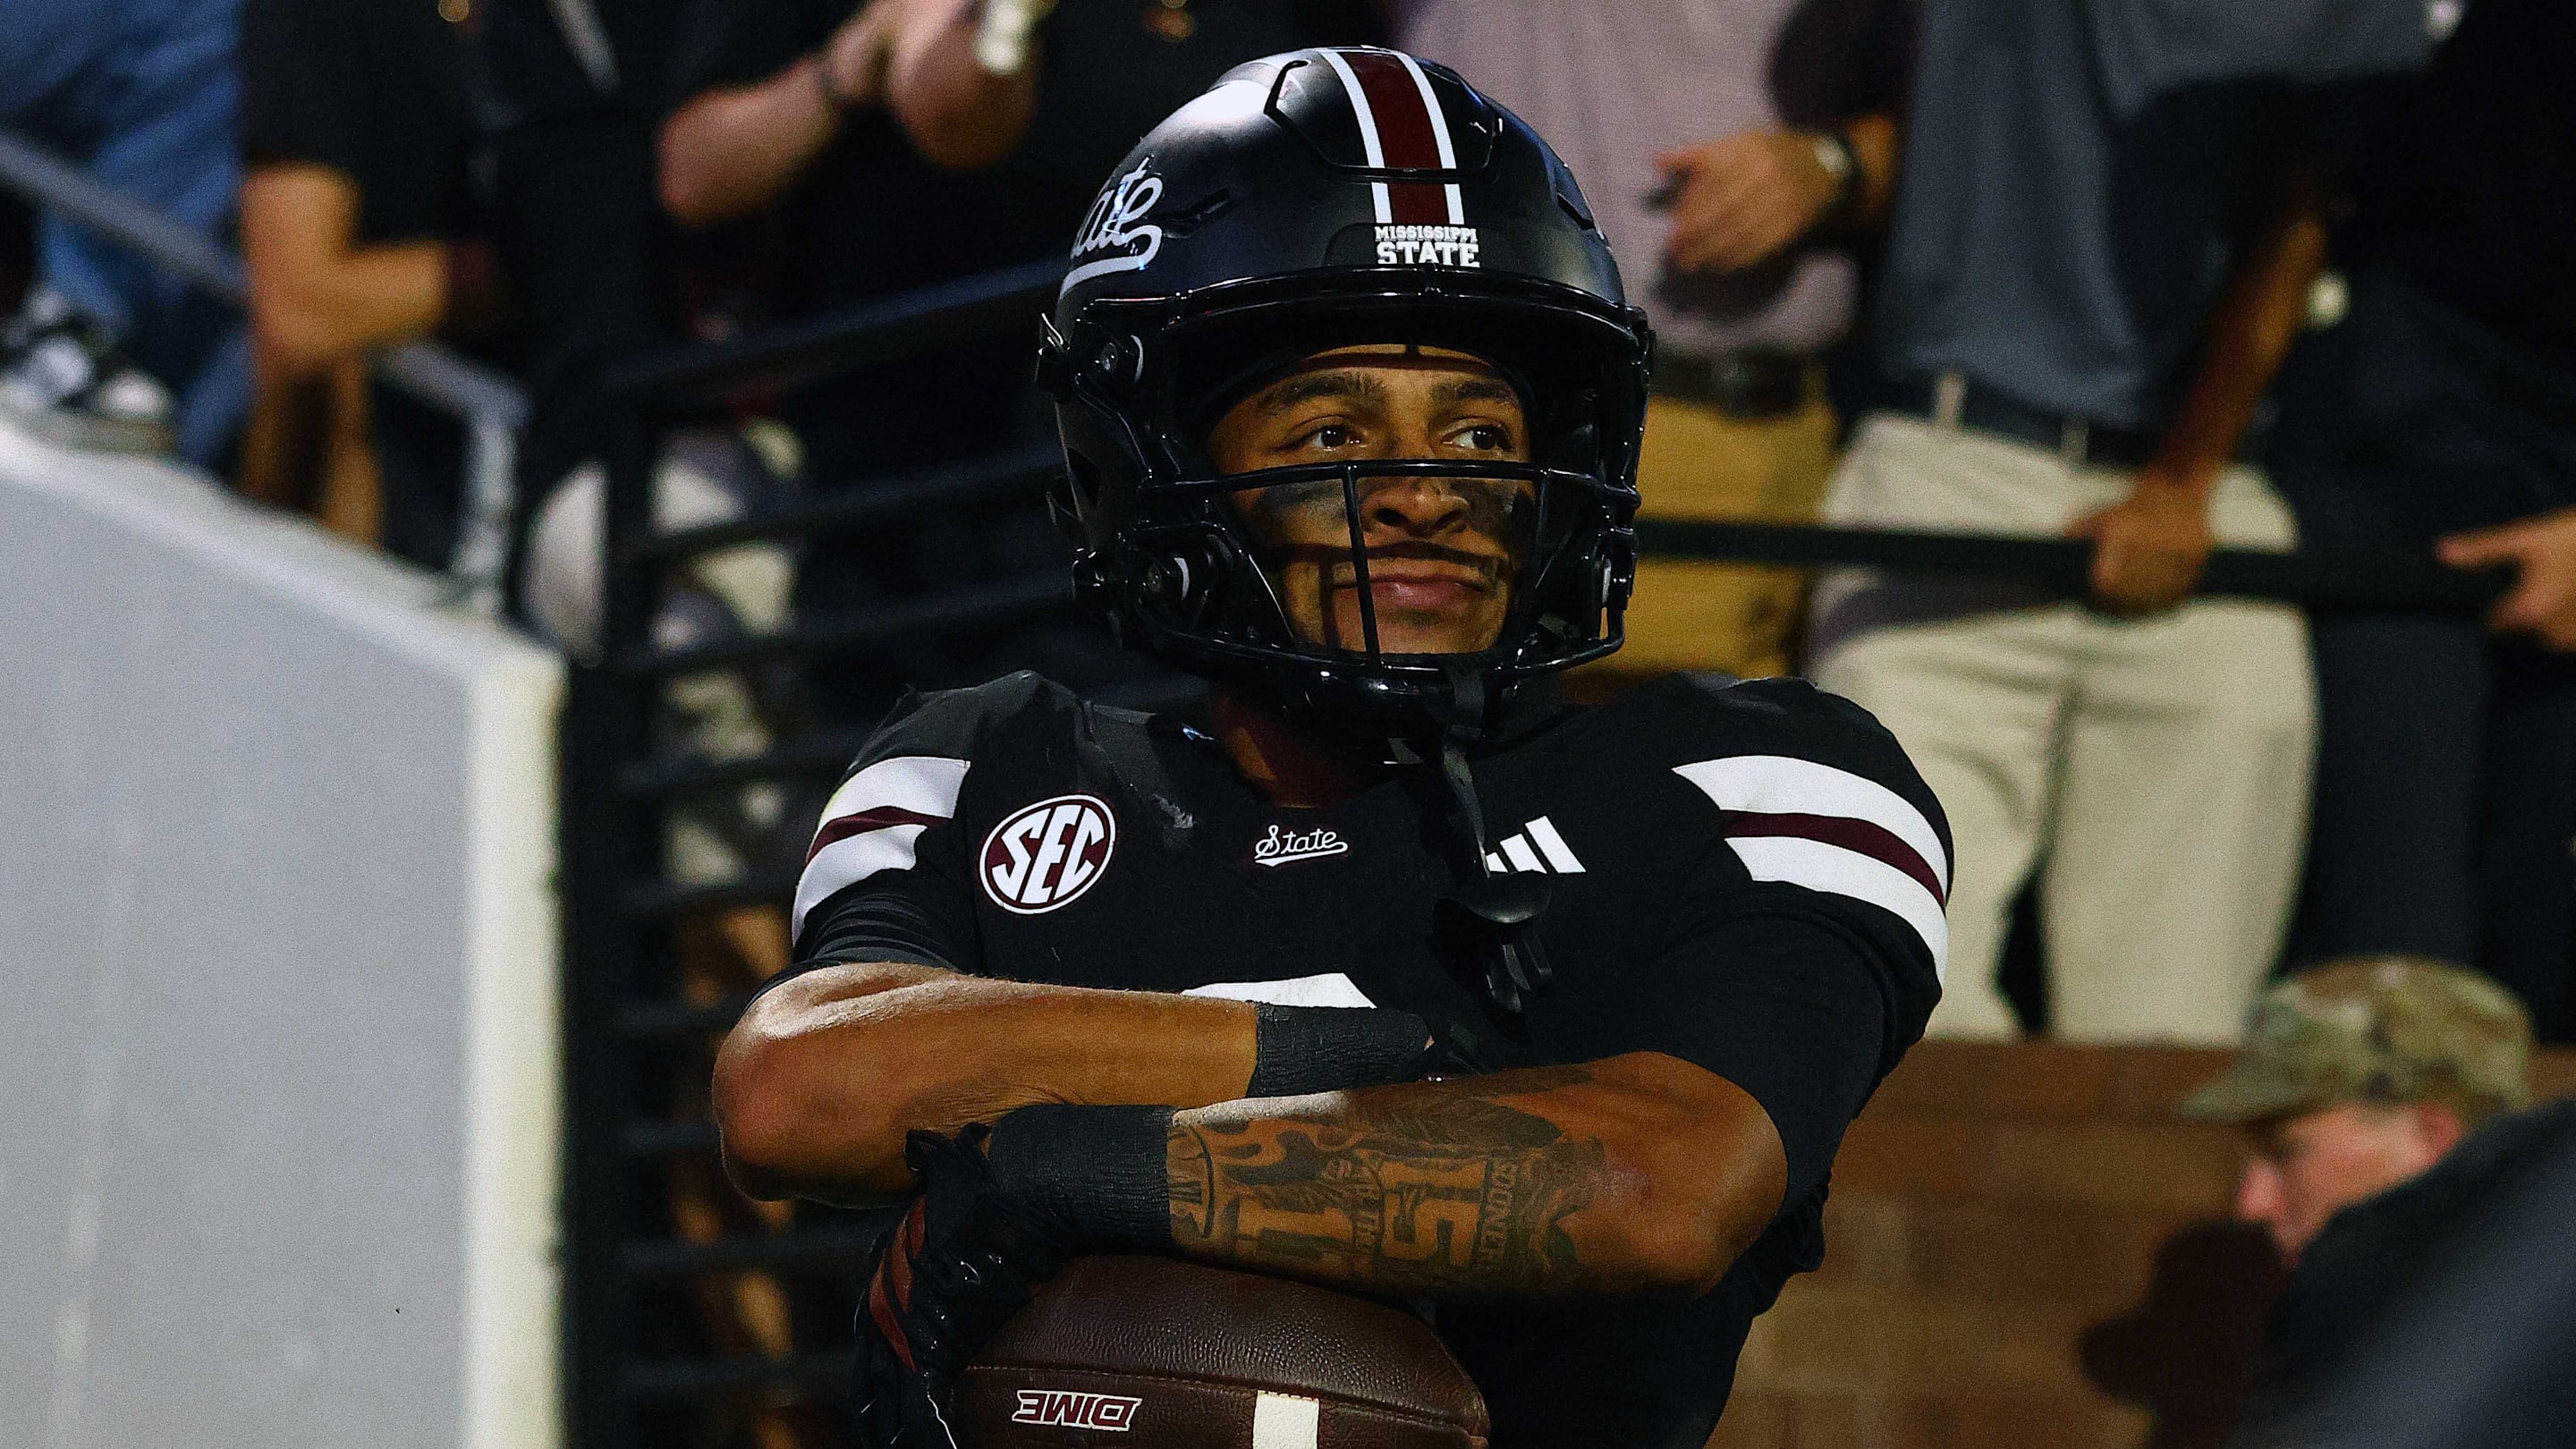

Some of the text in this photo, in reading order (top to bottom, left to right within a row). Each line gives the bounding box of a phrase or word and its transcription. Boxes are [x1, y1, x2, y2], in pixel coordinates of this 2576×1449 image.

[1374, 225, 1478, 243] MISSISSIPPI
[1377, 241, 1480, 267] STATE
[991, 804, 1106, 905] SEC
[1255, 824, 1348, 867] State
[1012, 1390, 1142, 1431] DIME
